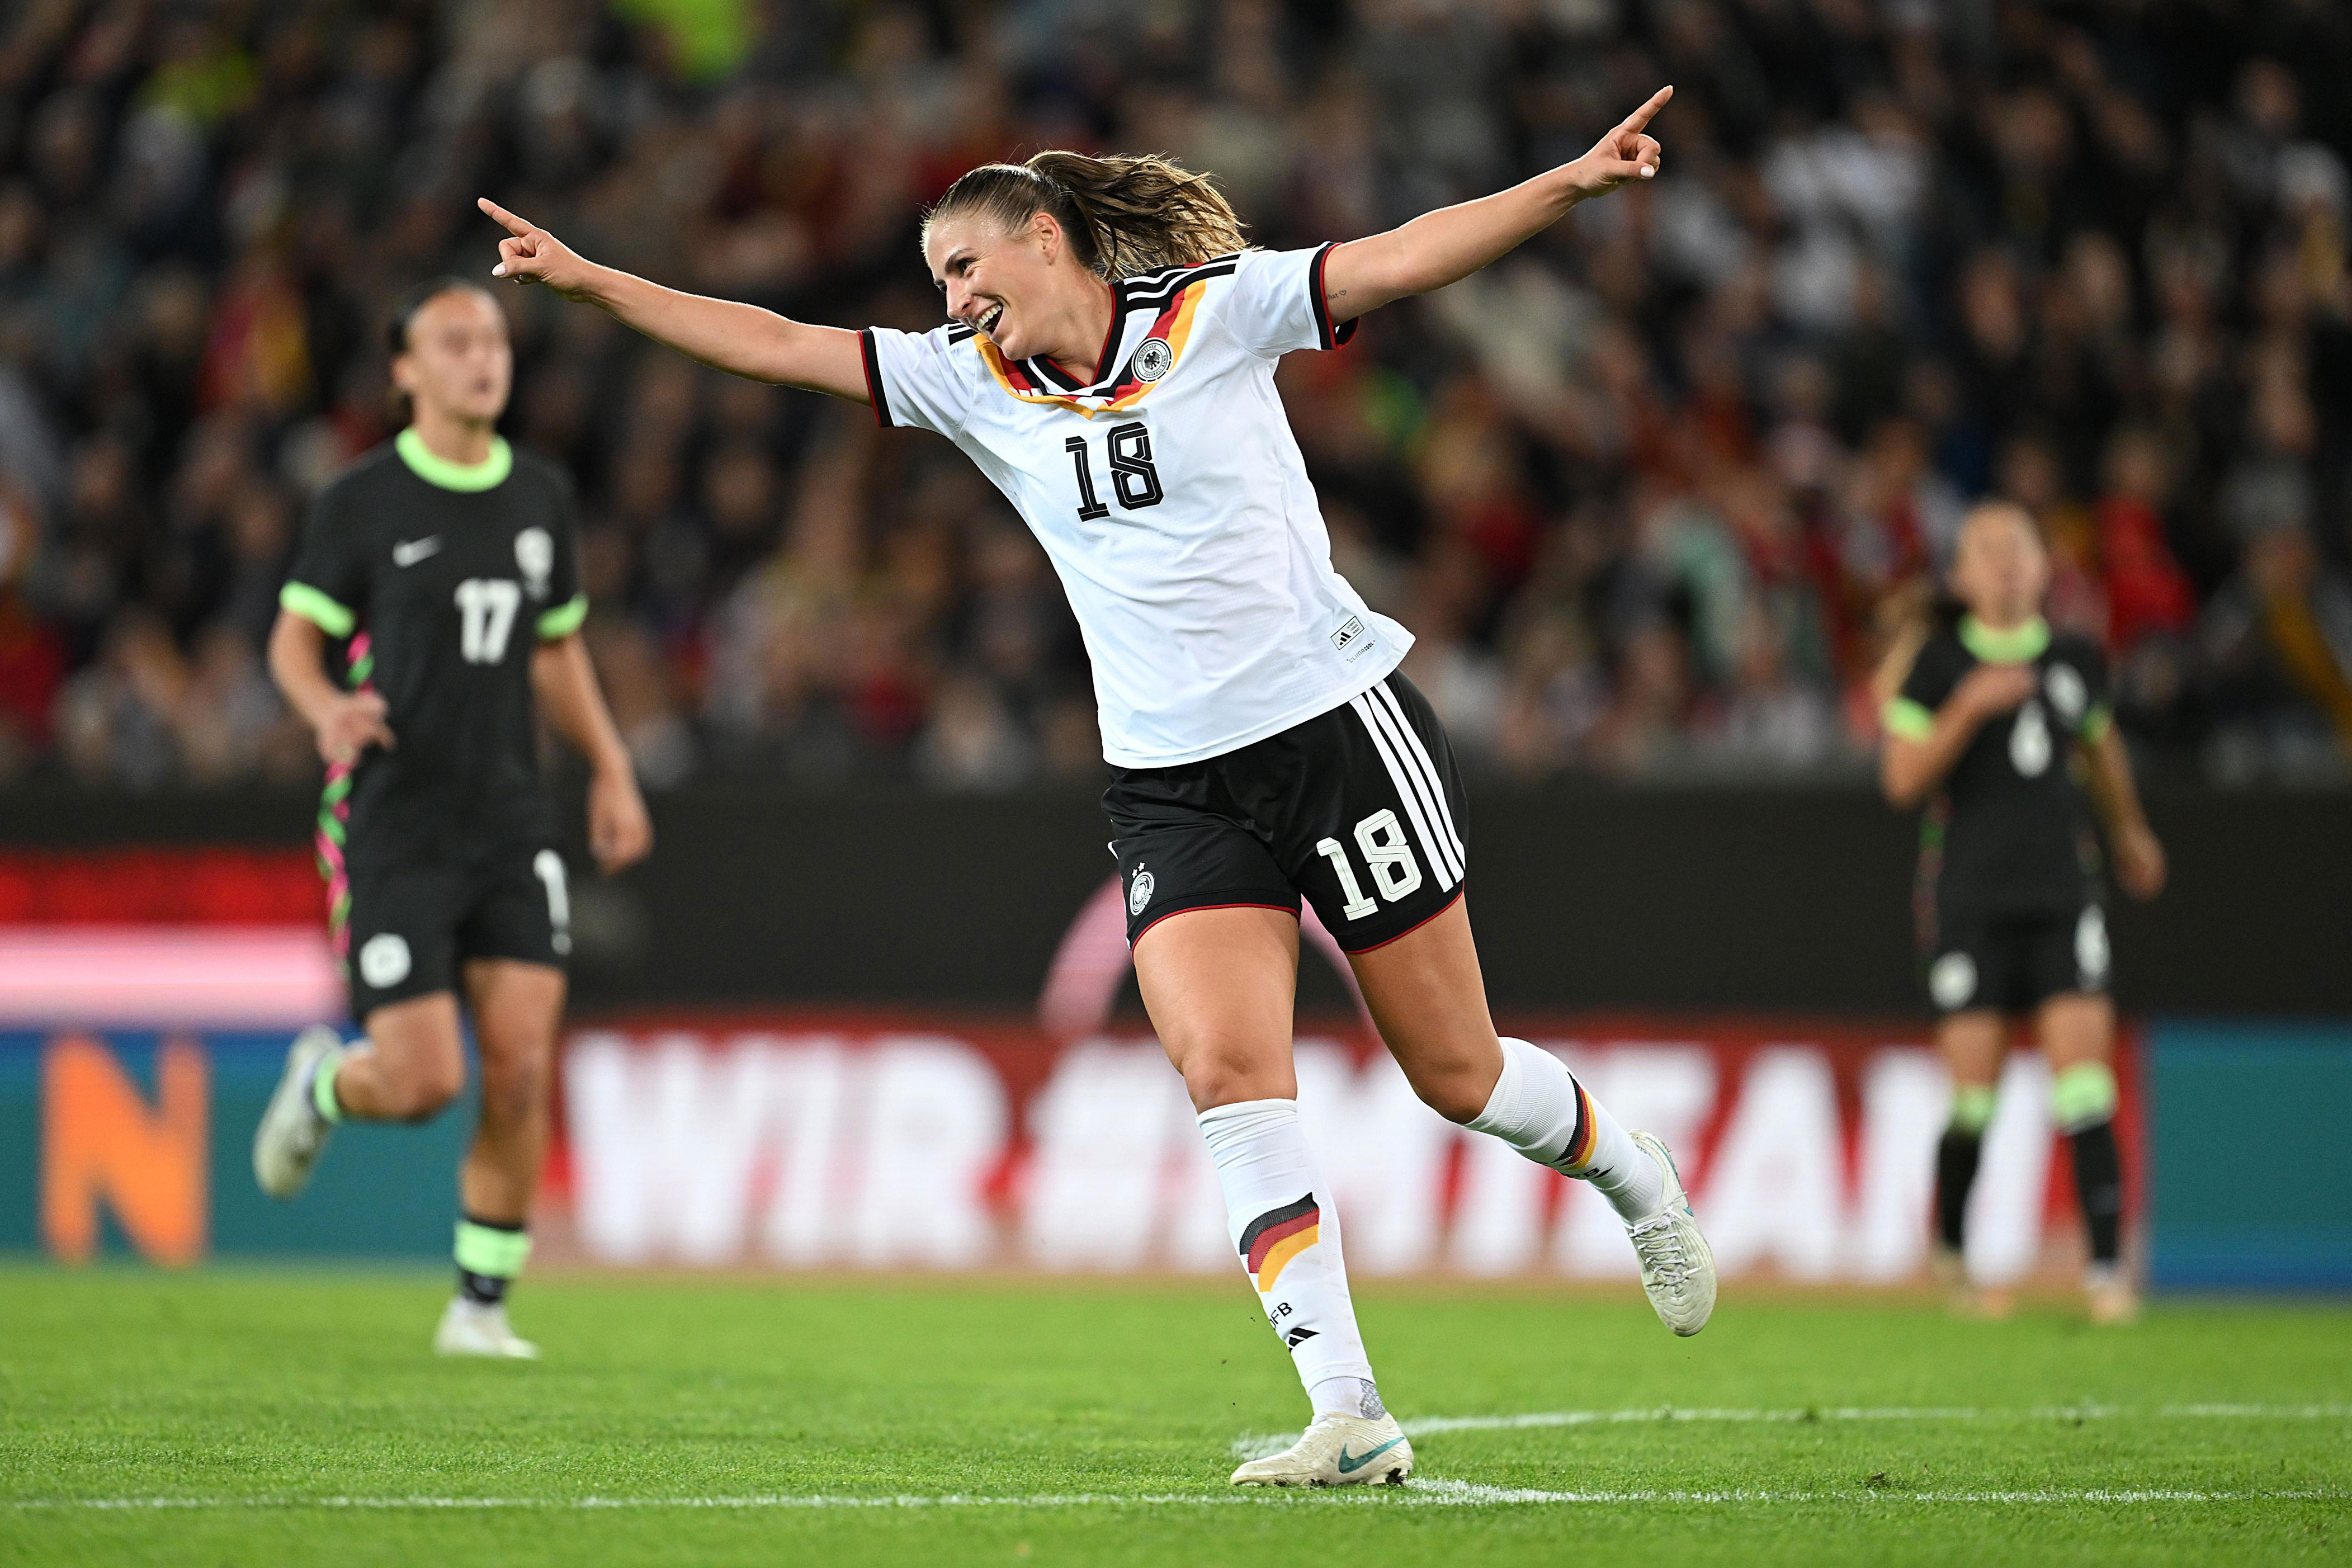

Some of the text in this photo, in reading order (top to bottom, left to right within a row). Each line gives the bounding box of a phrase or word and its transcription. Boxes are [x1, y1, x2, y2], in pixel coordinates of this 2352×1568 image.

[1065, 422, 1164, 522] 18
[454, 578, 521, 664] 17
[1316, 808, 1422, 921] 18
[42, 1036, 211, 1268] N
